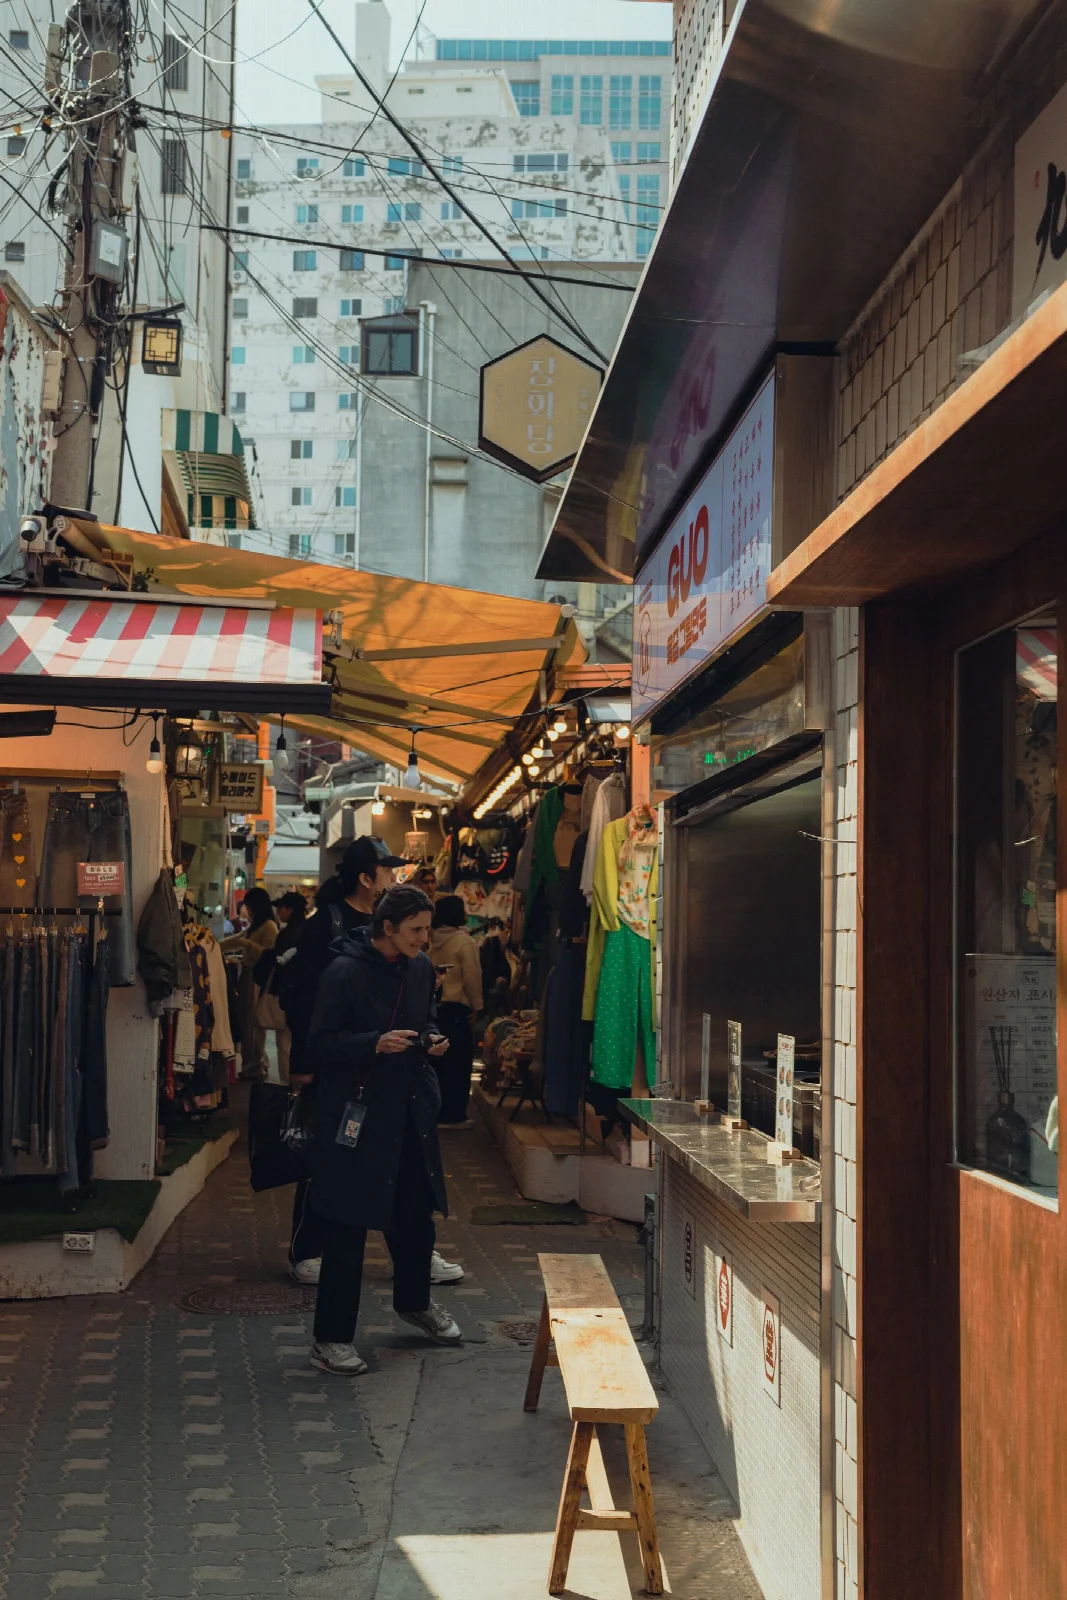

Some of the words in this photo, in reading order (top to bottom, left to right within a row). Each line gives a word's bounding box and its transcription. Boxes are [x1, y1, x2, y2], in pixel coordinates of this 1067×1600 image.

[667, 505, 709, 618] GUO
[980, 987, 1020, 1002] 원산지
[1026, 988, 1056, 1002] 표시
